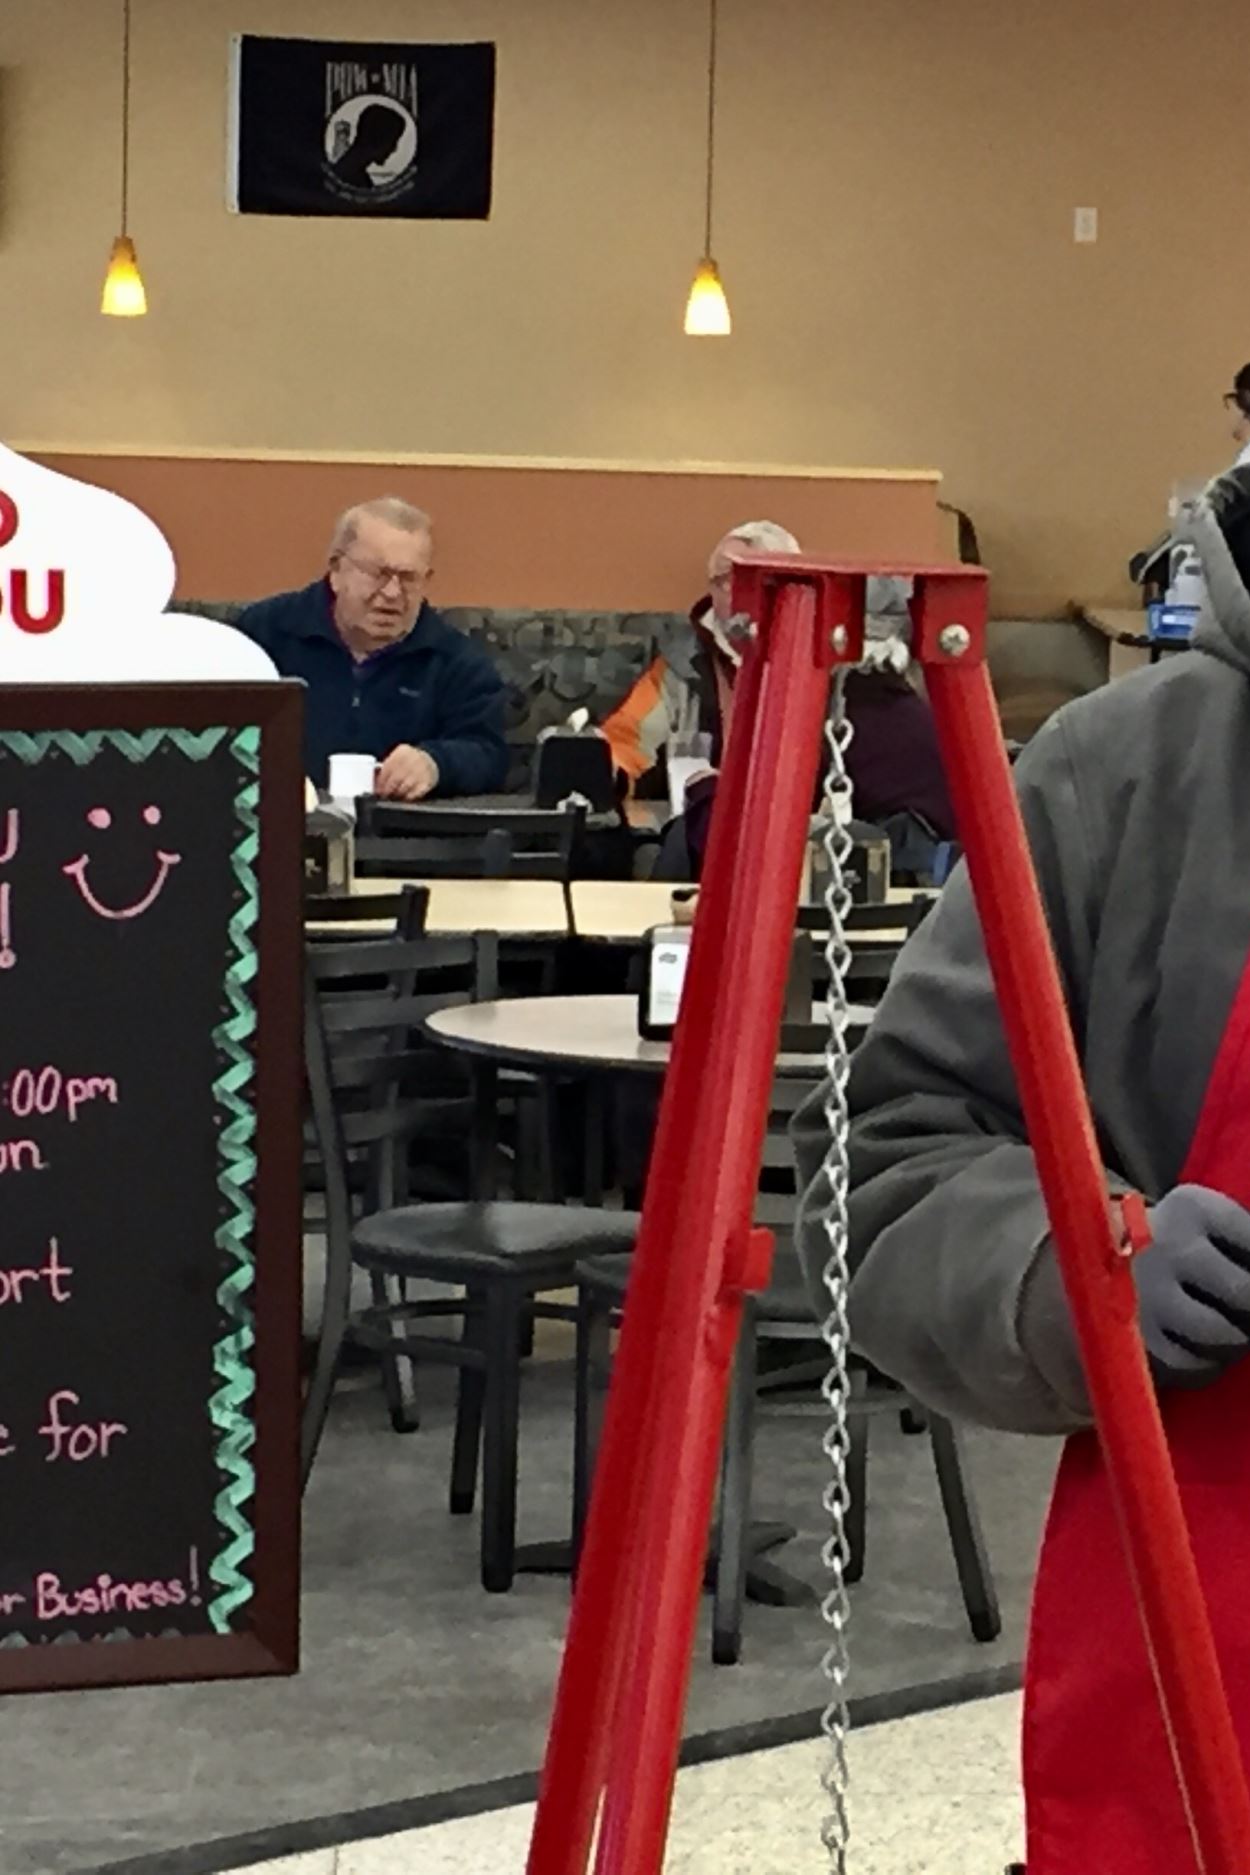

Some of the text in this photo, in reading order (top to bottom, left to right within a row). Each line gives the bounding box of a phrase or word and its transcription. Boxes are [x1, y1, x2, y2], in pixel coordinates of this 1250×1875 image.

[0, 569, 65, 634] U
[38, 1390, 128, 1461] for
[36, 1546, 202, 1619] Business!
